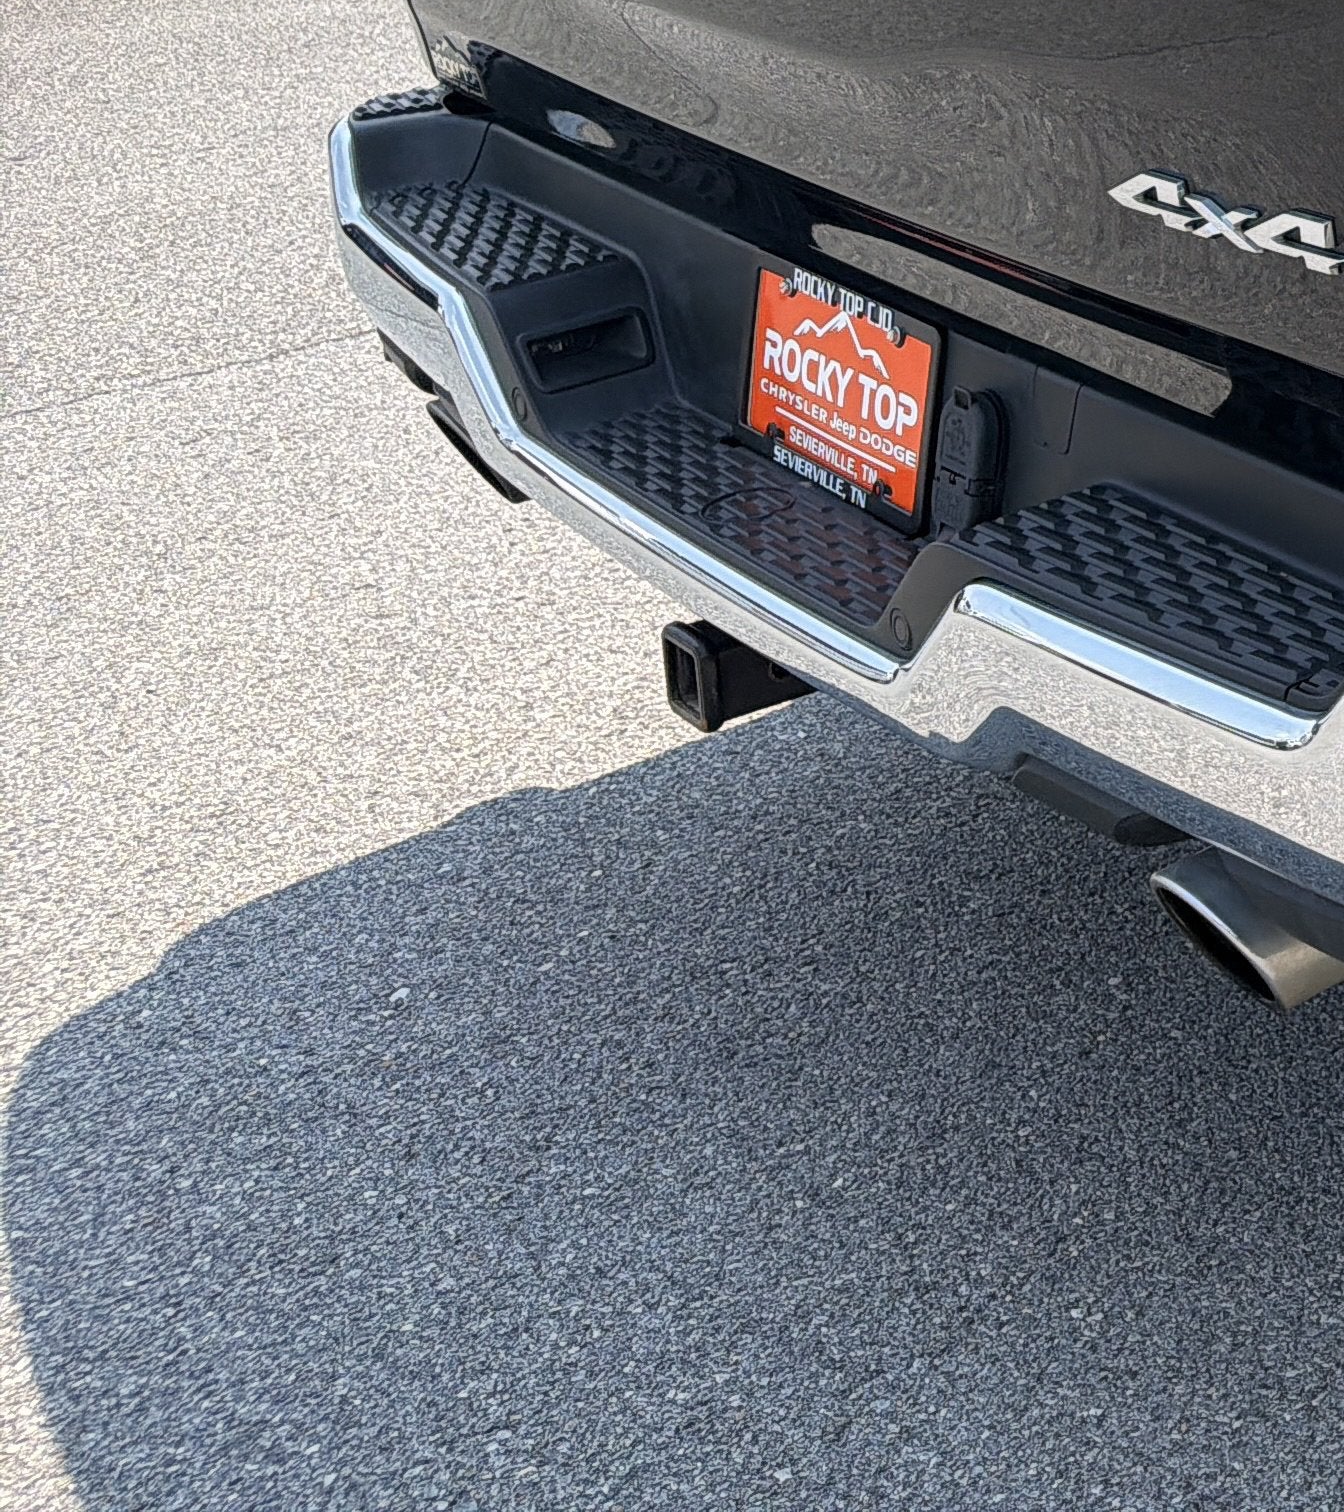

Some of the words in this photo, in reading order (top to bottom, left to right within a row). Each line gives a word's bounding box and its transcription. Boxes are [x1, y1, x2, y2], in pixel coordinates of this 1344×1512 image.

[793, 267, 836, 307] ROCKY
[838, 287, 864, 319] TOP
[867, 301, 893, 332] CJD
[762, 327, 855, 408] ROCKY
[858, 372, 919, 436] TOP
[760, 377, 828, 424] CHRYSLER
[829, 411, 857, 441] Jeep
[859, 426, 918, 469] DODGE
[788, 425, 858, 481] SEVIERVILLE,
[861, 463, 878, 485] TN
[773, 444, 847, 500] SEVIERVILLE,
[850, 485, 867, 509] TN
